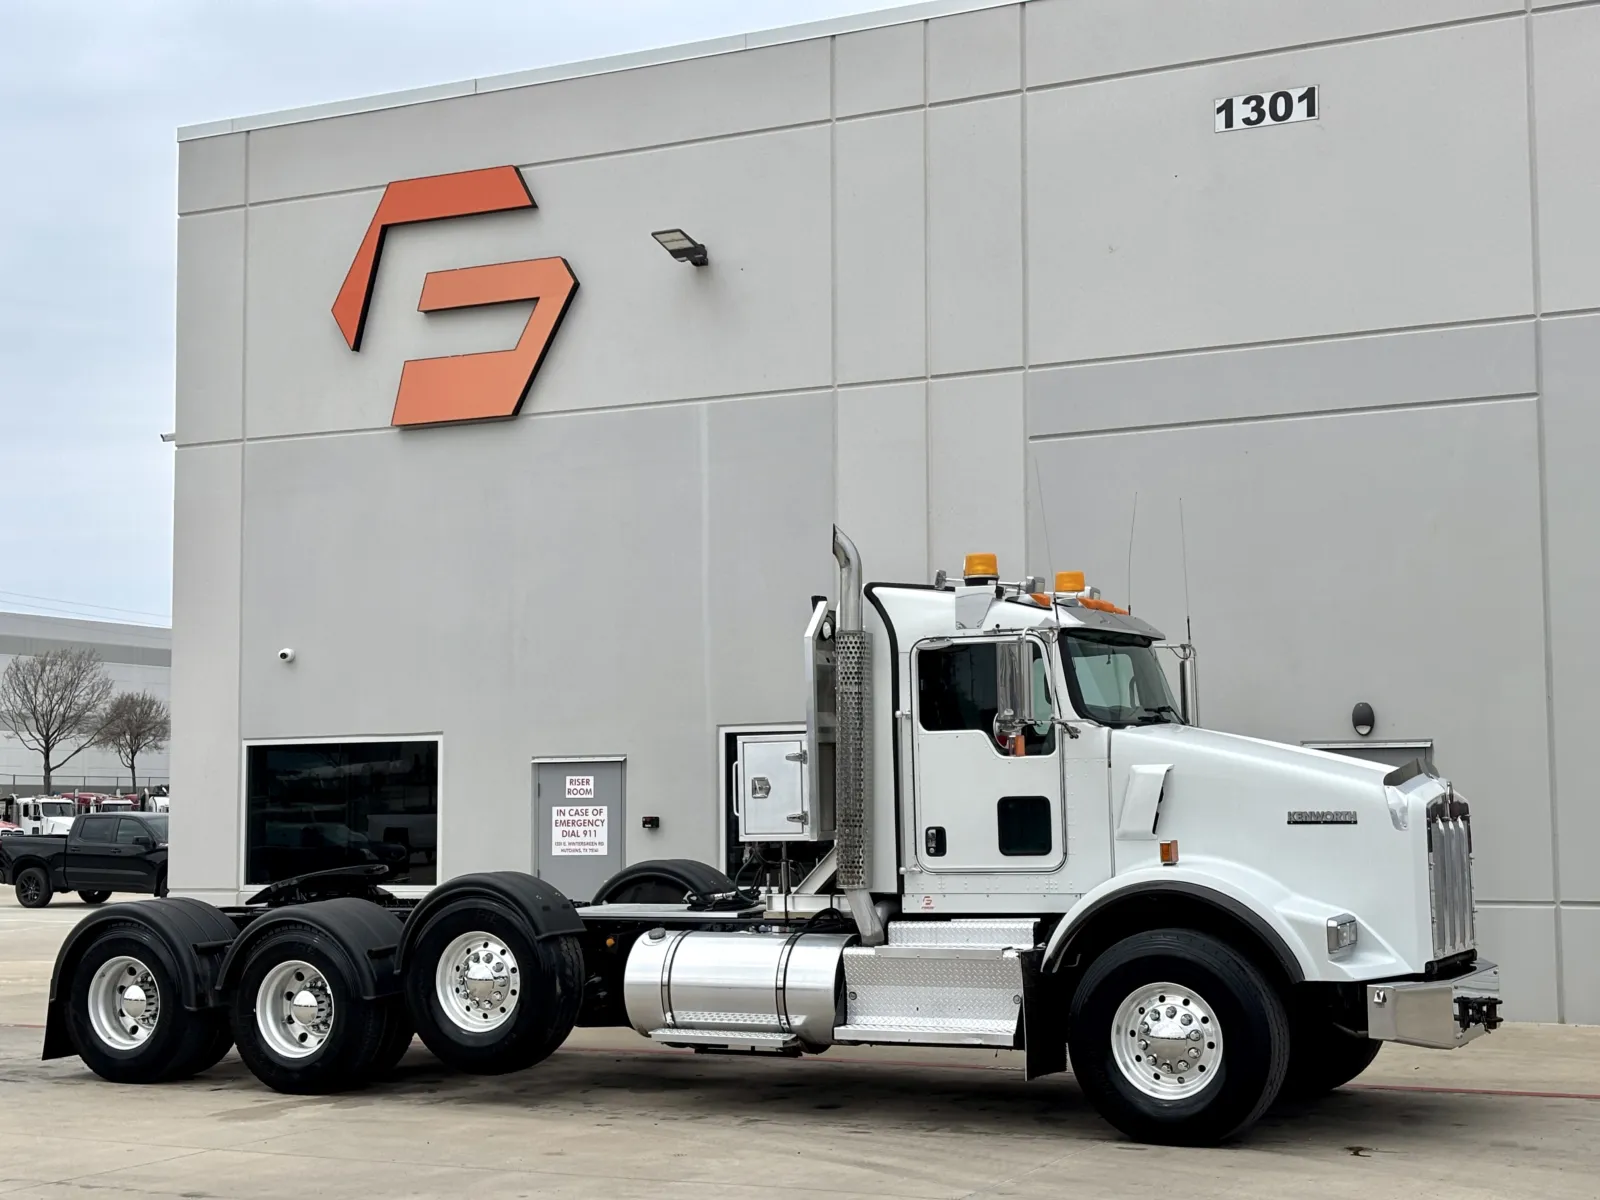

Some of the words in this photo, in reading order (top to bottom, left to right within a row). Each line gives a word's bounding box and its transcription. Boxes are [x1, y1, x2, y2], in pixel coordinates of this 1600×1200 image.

[1216, 86, 1316, 129] 1301
[569, 778, 590, 786] RISER
[567, 788, 592, 796] ROOM
[556, 808, 566, 817] IN
[568, 808, 590, 817] CASE
[591, 808, 604, 817] OF
[1287, 811, 1357, 822] KENWORTH
[555, 819, 605, 827] EMERGENCY
